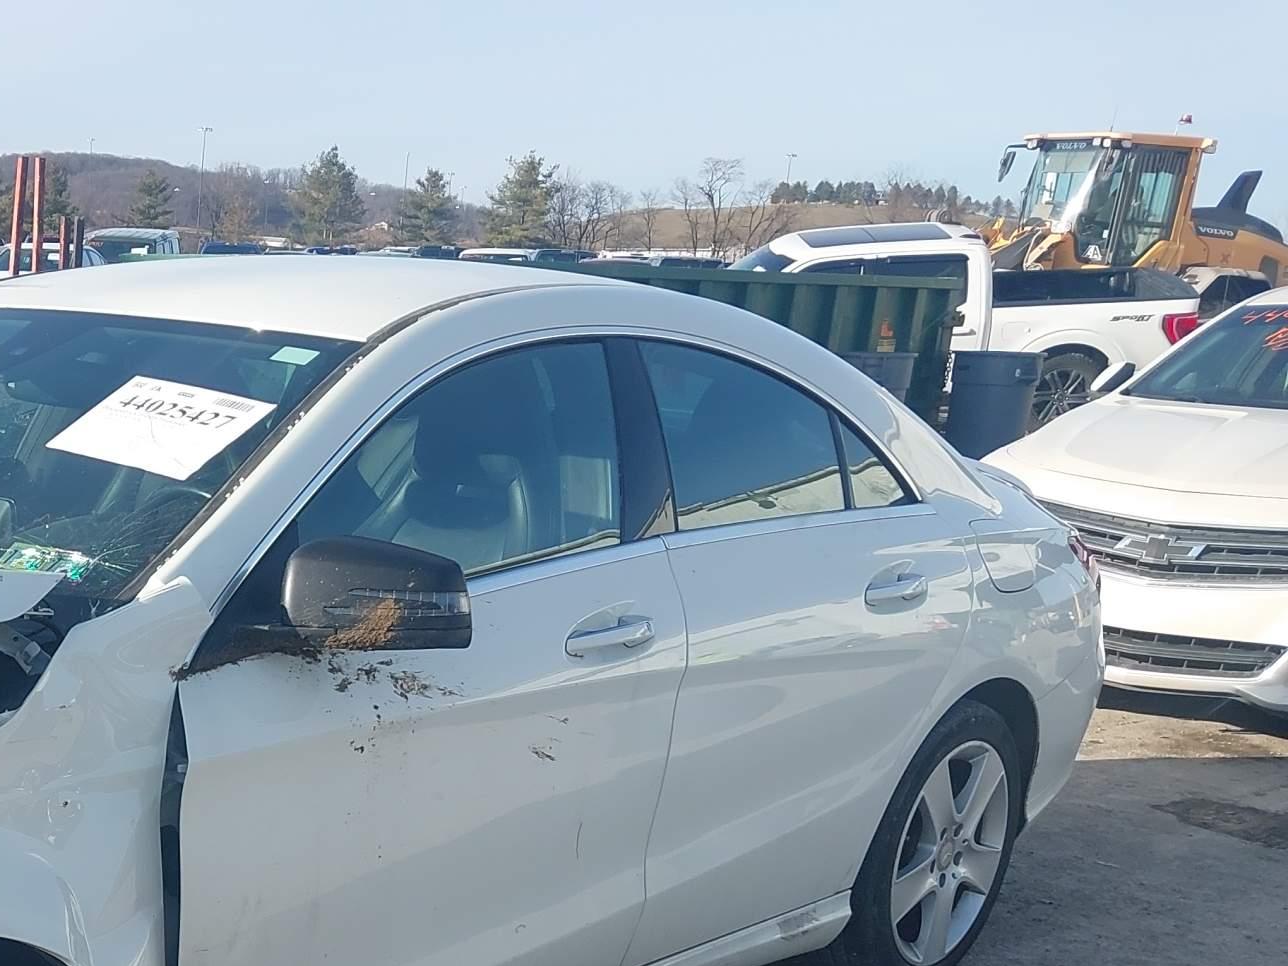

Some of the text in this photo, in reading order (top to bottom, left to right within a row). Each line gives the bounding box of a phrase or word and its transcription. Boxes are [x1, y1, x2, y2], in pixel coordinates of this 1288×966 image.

[1056, 142, 1087, 150] VOLVO
[1198, 225, 1234, 237] VOLVO
[1109, 314, 1155, 322] SPORT
[119, 395, 238, 430] 44025427
